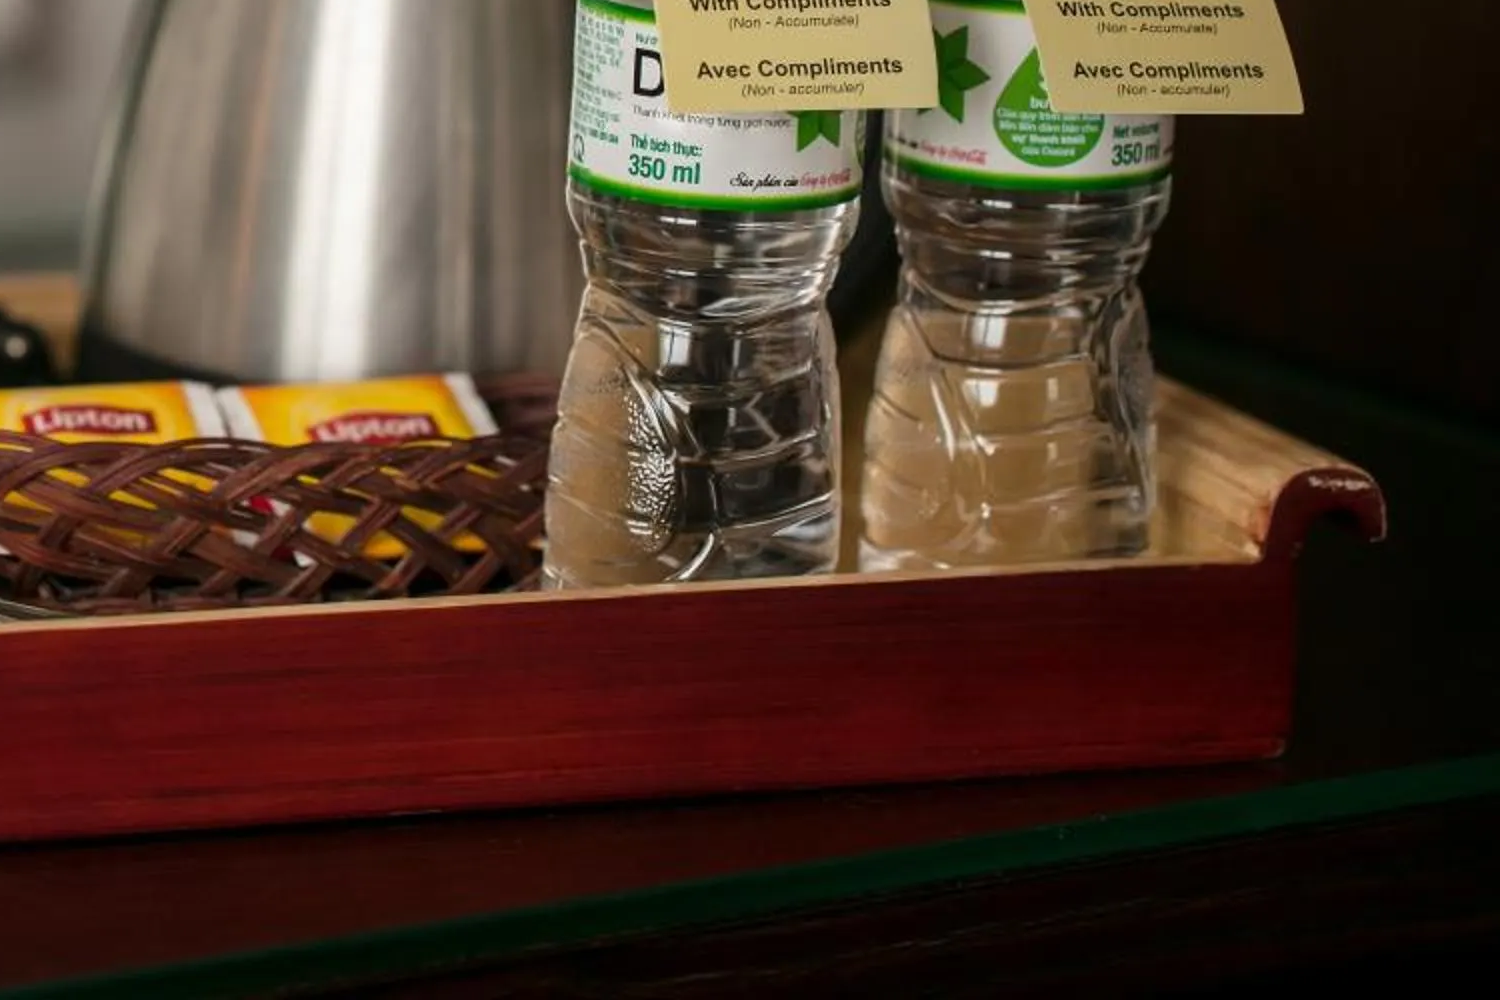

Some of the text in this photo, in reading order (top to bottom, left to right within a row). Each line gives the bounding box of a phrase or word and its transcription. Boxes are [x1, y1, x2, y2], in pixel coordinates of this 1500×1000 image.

[1056, 1, 1245, 21] With Compliments
[728, 16, 761, 31] (Non
[774, 14, 860, 29] Accumulate)
[1097, 22, 1127, 34] (Non
[1139, 22, 1218, 35] Accumulate)
[696, 58, 904, 80] Avec Compliments
[1073, 61, 1264, 82] Avec Compliments
[741, 84, 775, 97] (Non
[788, 82, 865, 96] accumuler)
[1116, 83, 1147, 97] (Non
[1160, 83, 1231, 97] accumuler)
[1111, 138, 1160, 167] 350 ml
[627, 153, 702, 185] 350 ml
[31, 406, 150, 434] Lipton
[315, 415, 433, 446] Lipton
